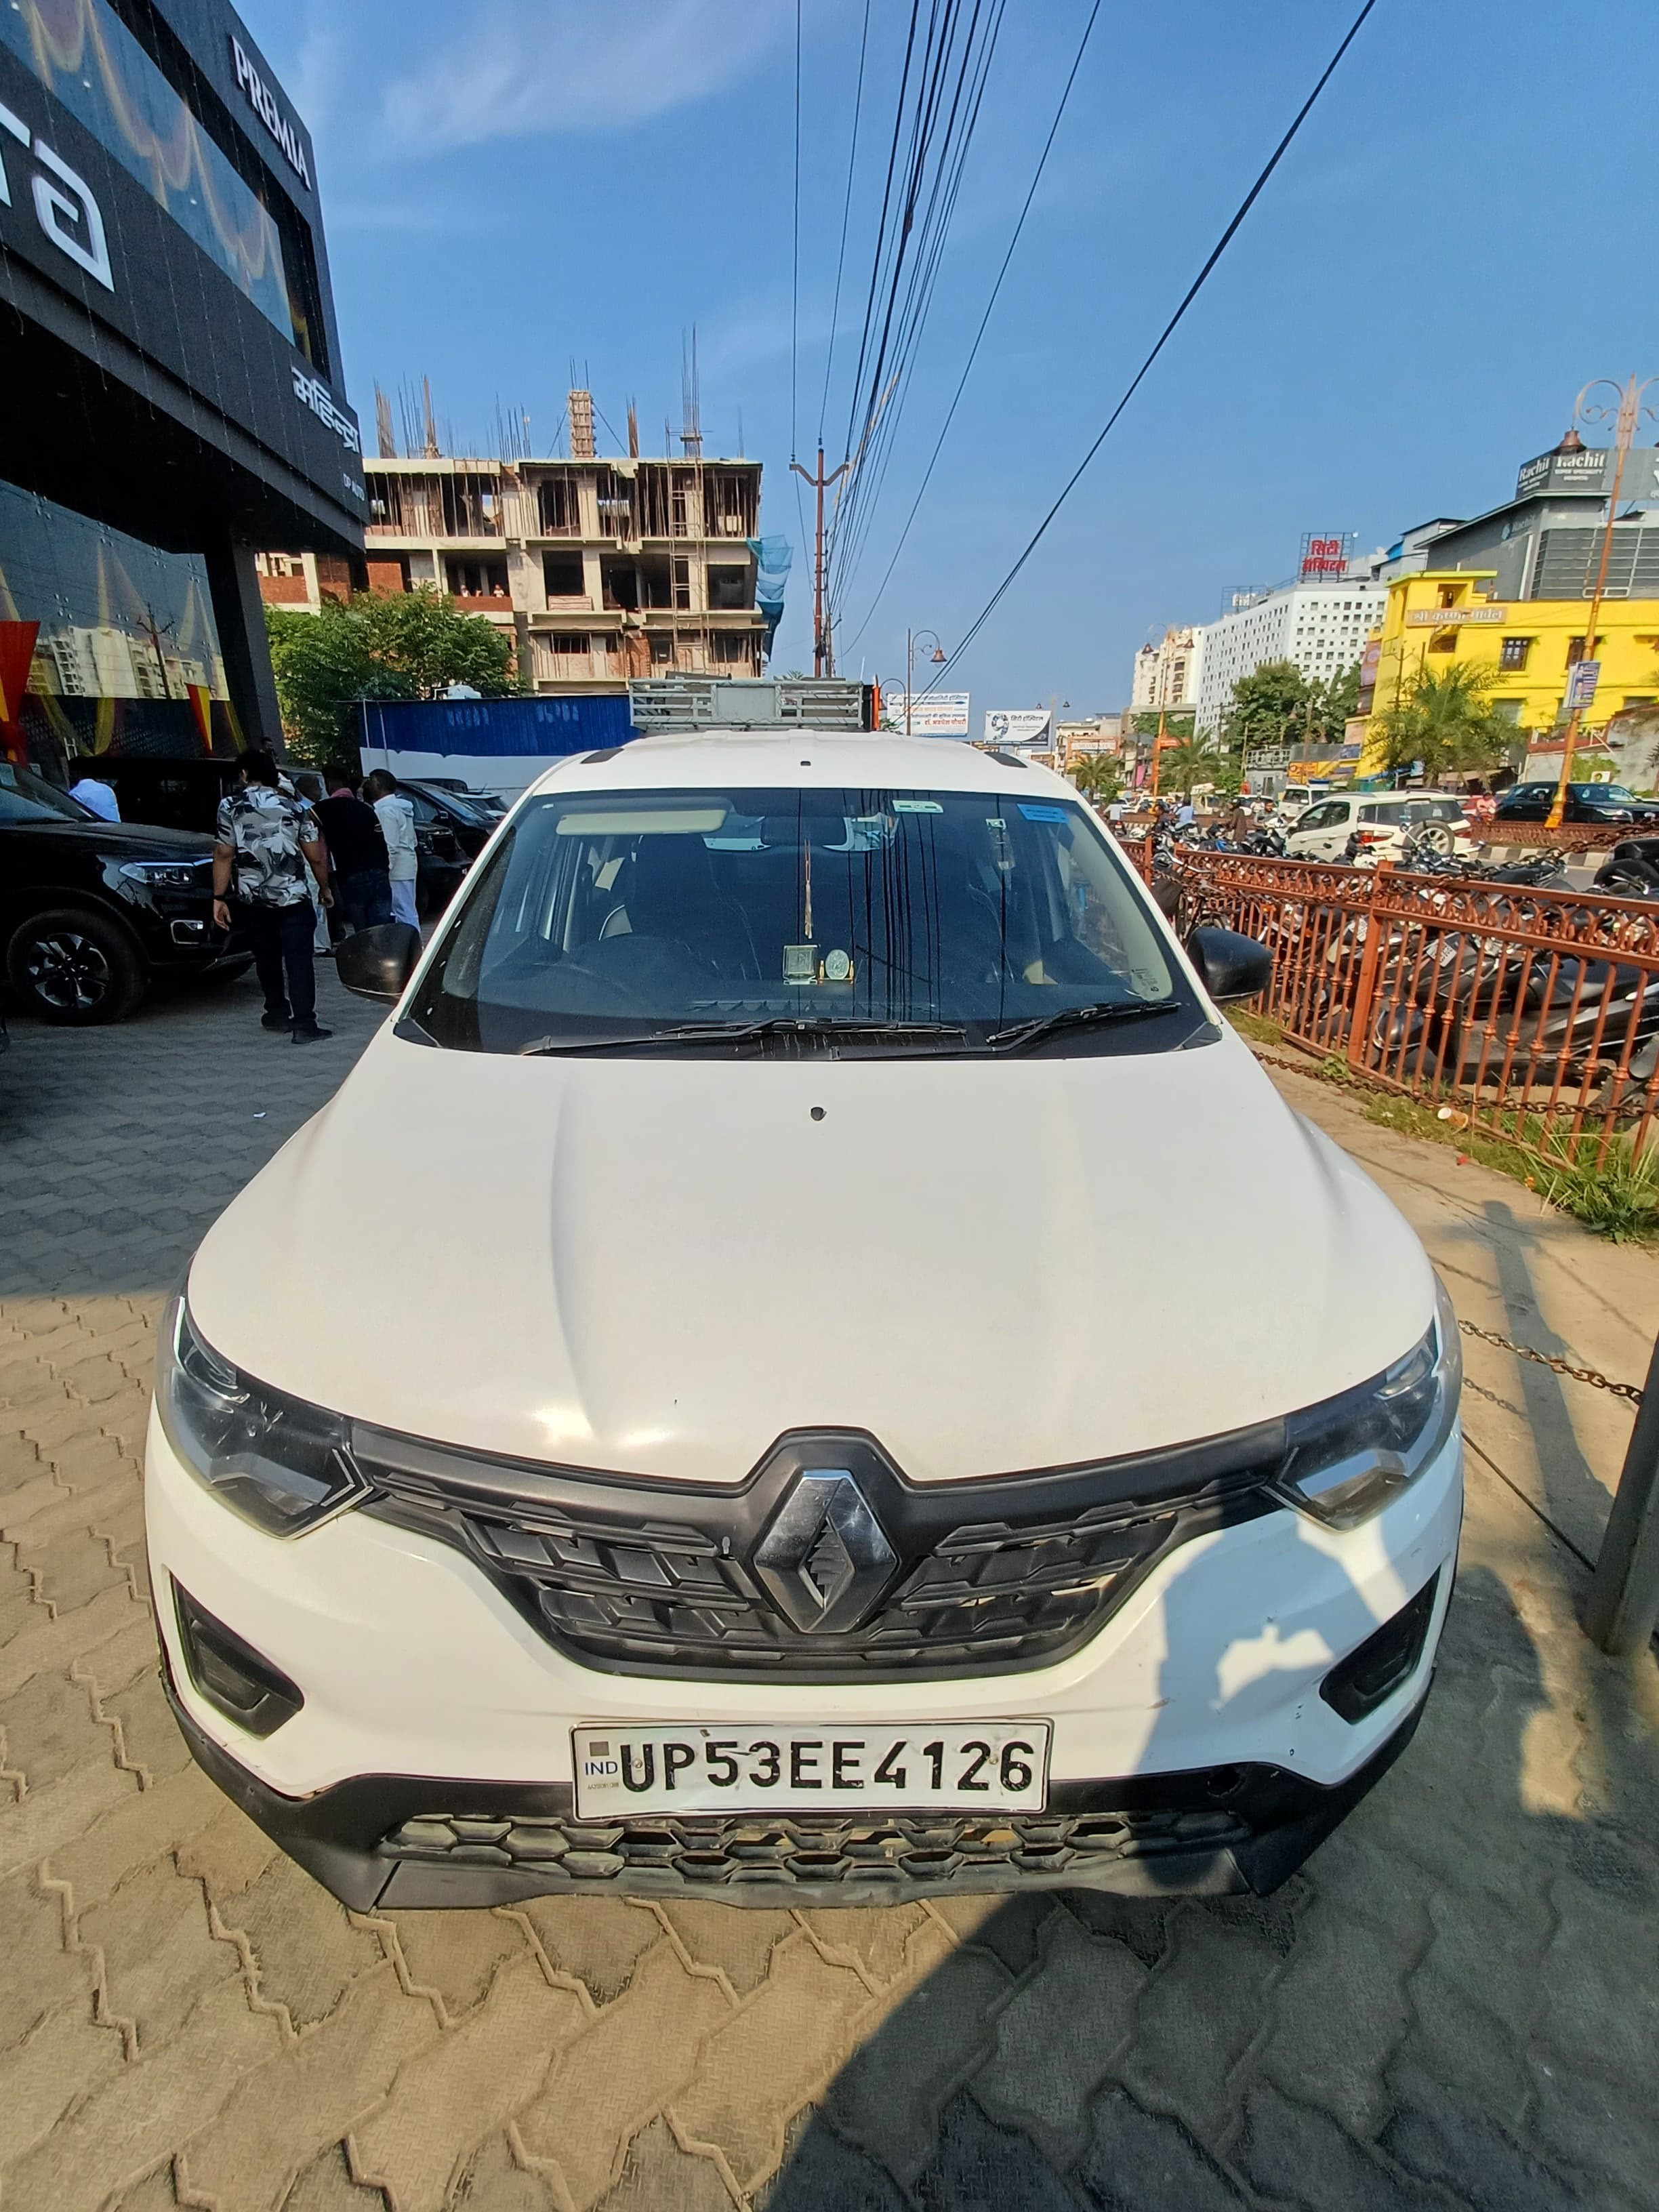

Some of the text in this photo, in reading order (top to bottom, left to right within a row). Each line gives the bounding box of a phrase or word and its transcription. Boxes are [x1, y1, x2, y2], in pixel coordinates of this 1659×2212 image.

[232, 35, 312, 192] PREMIA
[291, 366, 359, 453] महिन्द्रा
[585, 1740, 1035, 1793] IND UP53EE4126
